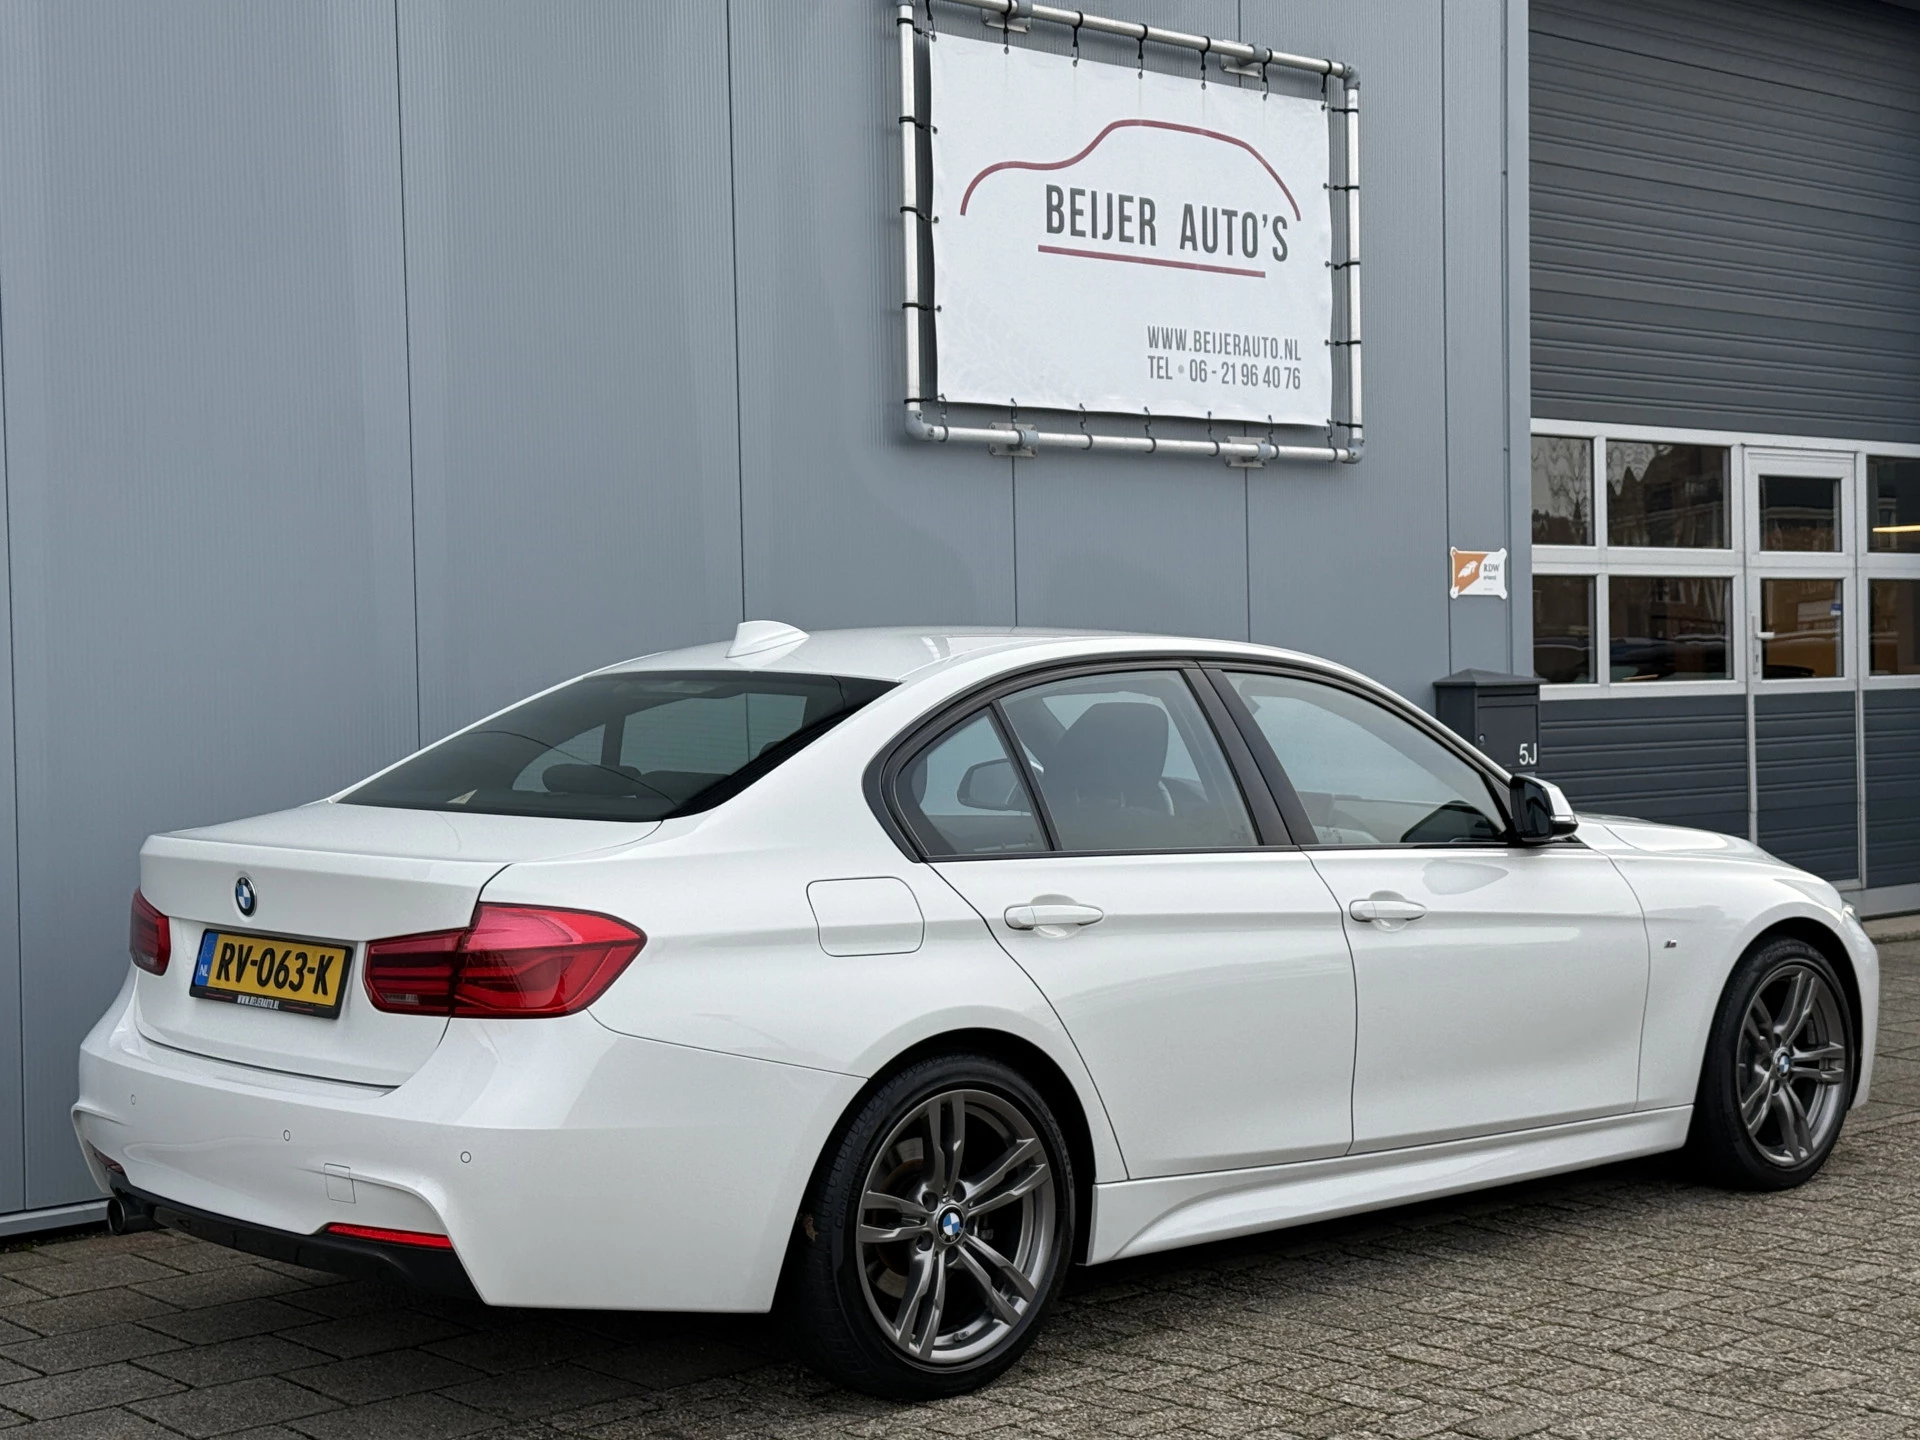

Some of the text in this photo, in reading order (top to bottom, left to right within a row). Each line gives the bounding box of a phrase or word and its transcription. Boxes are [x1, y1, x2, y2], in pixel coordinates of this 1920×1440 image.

[1046, 184, 1289, 262] BEIJER AUTO'S
[1147, 325, 1302, 361] WWW.BEIJERAUTO.NL
[1147, 355, 1173, 380] TEL
[1189, 359, 1208, 383] 06
[1221, 361, 1236, 385] 21
[1241, 363, 1259, 387] 96
[1262, 365, 1281, 389] 40
[1284, 367, 1301, 390] 76
[1519, 743, 1537, 765] 5J
[199, 964, 208, 977] NL
[216, 942, 335, 996] RV-063-K
